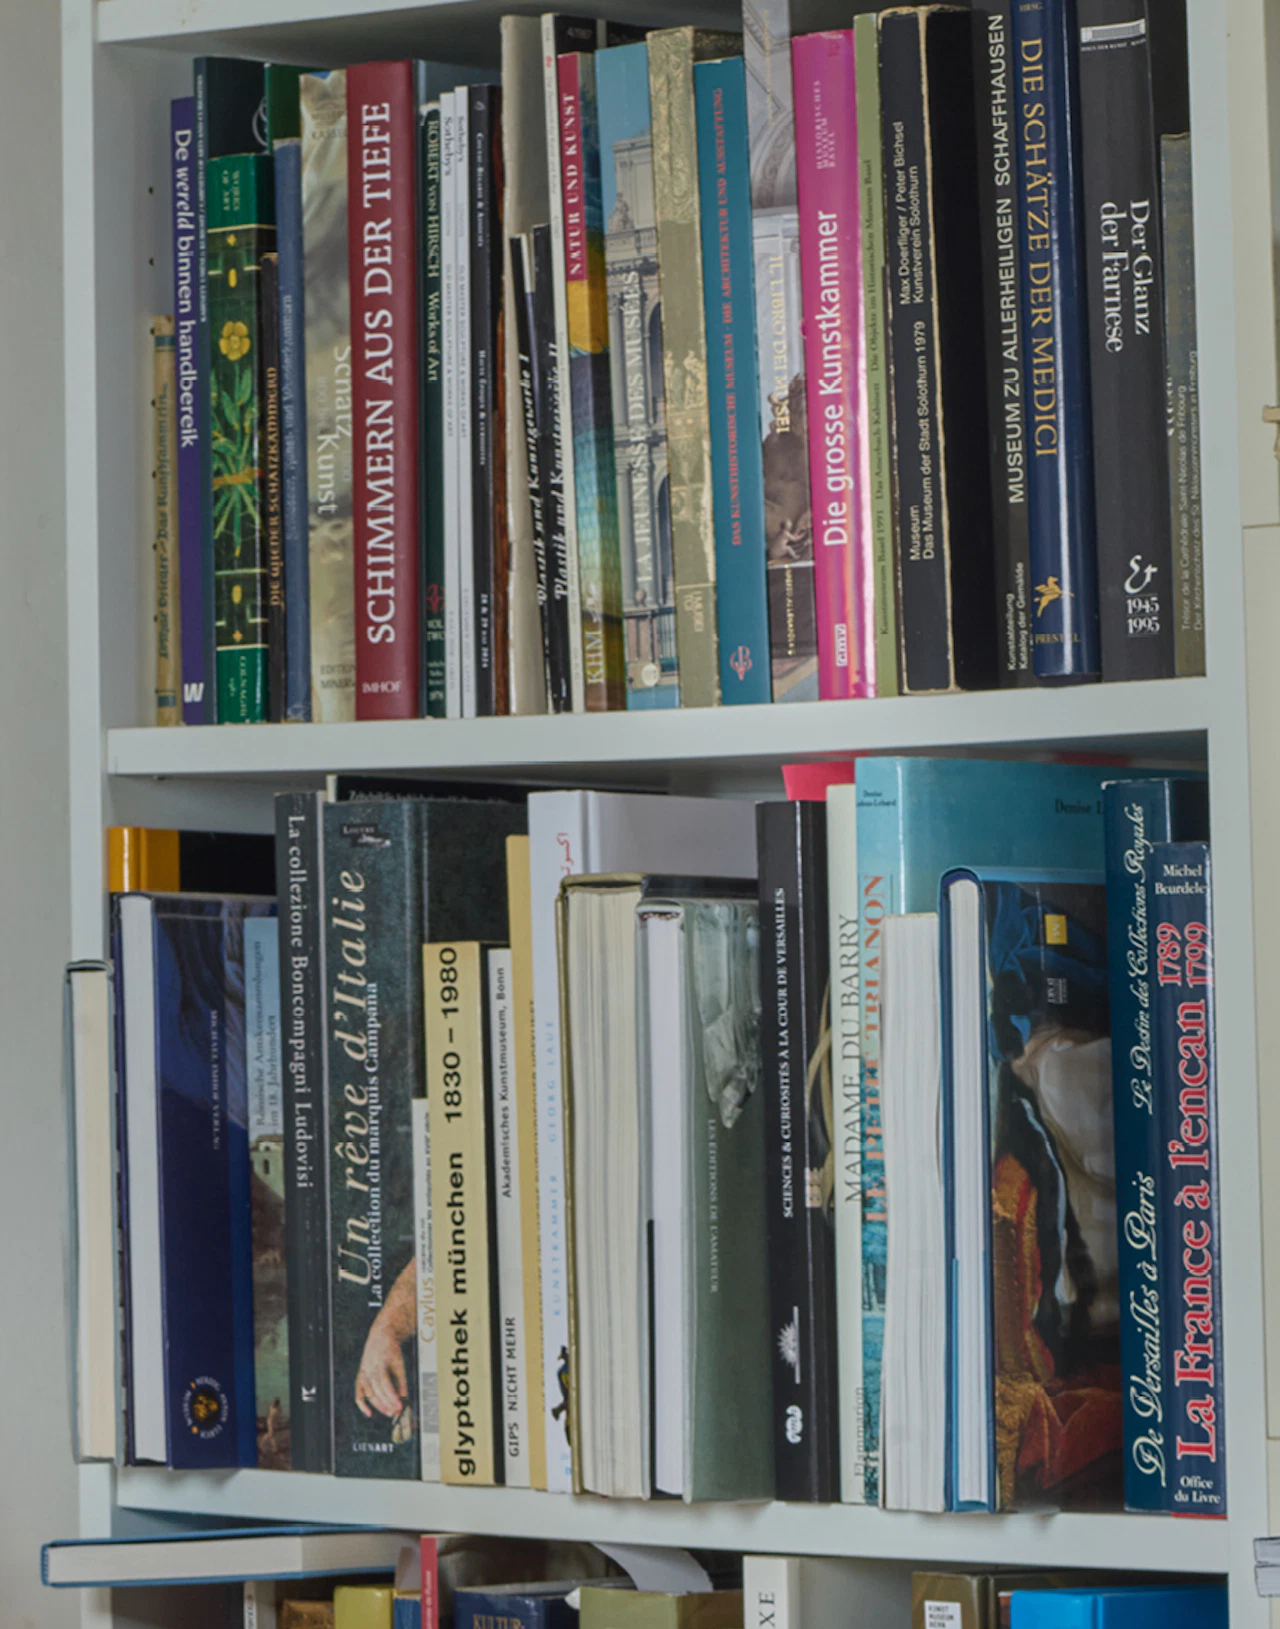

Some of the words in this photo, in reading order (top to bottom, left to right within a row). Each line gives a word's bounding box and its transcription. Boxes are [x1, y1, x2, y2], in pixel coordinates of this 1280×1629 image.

[1021, 38, 1044, 94] DIE
[558, 92, 578, 155] KUNST
[989, 14, 1012, 186] SCHAFFHAUSEN
[175, 130, 192, 161] De
[361, 103, 391, 208] TIEFE
[1023, 102, 1053, 251] SCHÄTZE
[176, 167, 195, 230] wereld
[561, 163, 579, 203] UND
[908, 166, 922, 226] Solothurn
[564, 212, 583, 275] NATUR
[1100, 202, 1128, 247] der
[1130, 201, 1150, 247] Der
[178, 236, 196, 313] binnen
[362, 218, 392, 297] DER
[911, 228, 925, 303] Kunstverein
[996, 199, 1018, 360] ALLERHEILIGEN
[816, 211, 846, 396] Kunstkammer
[1030, 262, 1053, 327] DER
[1102, 250, 1129, 353] Farnese
[1132, 254, 1154, 334] Glanz
[364, 309, 394, 386] AUS
[914, 321, 927, 352] 1979
[180, 320, 197, 448] handbereik
[915, 356, 928, 417] Solothurn
[1003, 368, 1020, 396] ZU
[1031, 336, 1058, 456] MEDICI
[822, 403, 854, 493] grosse
[917, 420, 930, 451] Stadt
[918, 454, 931, 473] der
[1003, 402, 1024, 503] MUSEUM
[316, 432, 340, 515] Kunst
[919, 477, 934, 530] Museum
[365, 401, 395, 645] SCHIMMERN
[823, 500, 849, 545] Die
[910, 505, 922, 560] Museum
[922, 534, 935, 559] Das
[1126, 597, 1160, 615] 1945
[1127, 616, 1160, 634] 1995
[585, 629, 605, 685] KHM
[288, 816, 306, 841] La
[288, 847, 307, 949] collezione
[1163, 864, 1203, 877] Michel
[332, 868, 368, 1061] d'Italie
[495, 967, 507, 1001] Bonn
[838, 914, 860, 1007] BARRY
[1156, 922, 1182, 987] 1789
[1183, 921, 1214, 989] 1799
[288, 956, 310, 1094] Boncompagni
[362, 982, 382, 1073] Campana
[497, 1005, 510, 1102] Kunstmuseum,
[841, 1020, 861, 1060] DU
[363, 1076, 383, 1151] marquis
[1168, 999, 1209, 1171] l'encan
[293, 1102, 314, 1189] Ludovisi
[335, 1083, 371, 1193] rêve
[364, 1159, 381, 1183] du
[500, 1106, 512, 1199] Akademisches
[841, 1074, 863, 1202] MADAME
[1173, 1179, 1210, 1210] à
[337, 1216, 372, 1287] Un
[365, 1187, 383, 1281] collection
[366, 1282, 383, 1308] La
[1174, 1220, 1215, 1388] France
[505, 1316, 517, 1360] MEHR
[506, 1365, 519, 1412] NICHT
[508, 1422, 520, 1458] GIPS
[1176, 1394, 1216, 1463] La
[1180, 1475, 1214, 1490] Office
